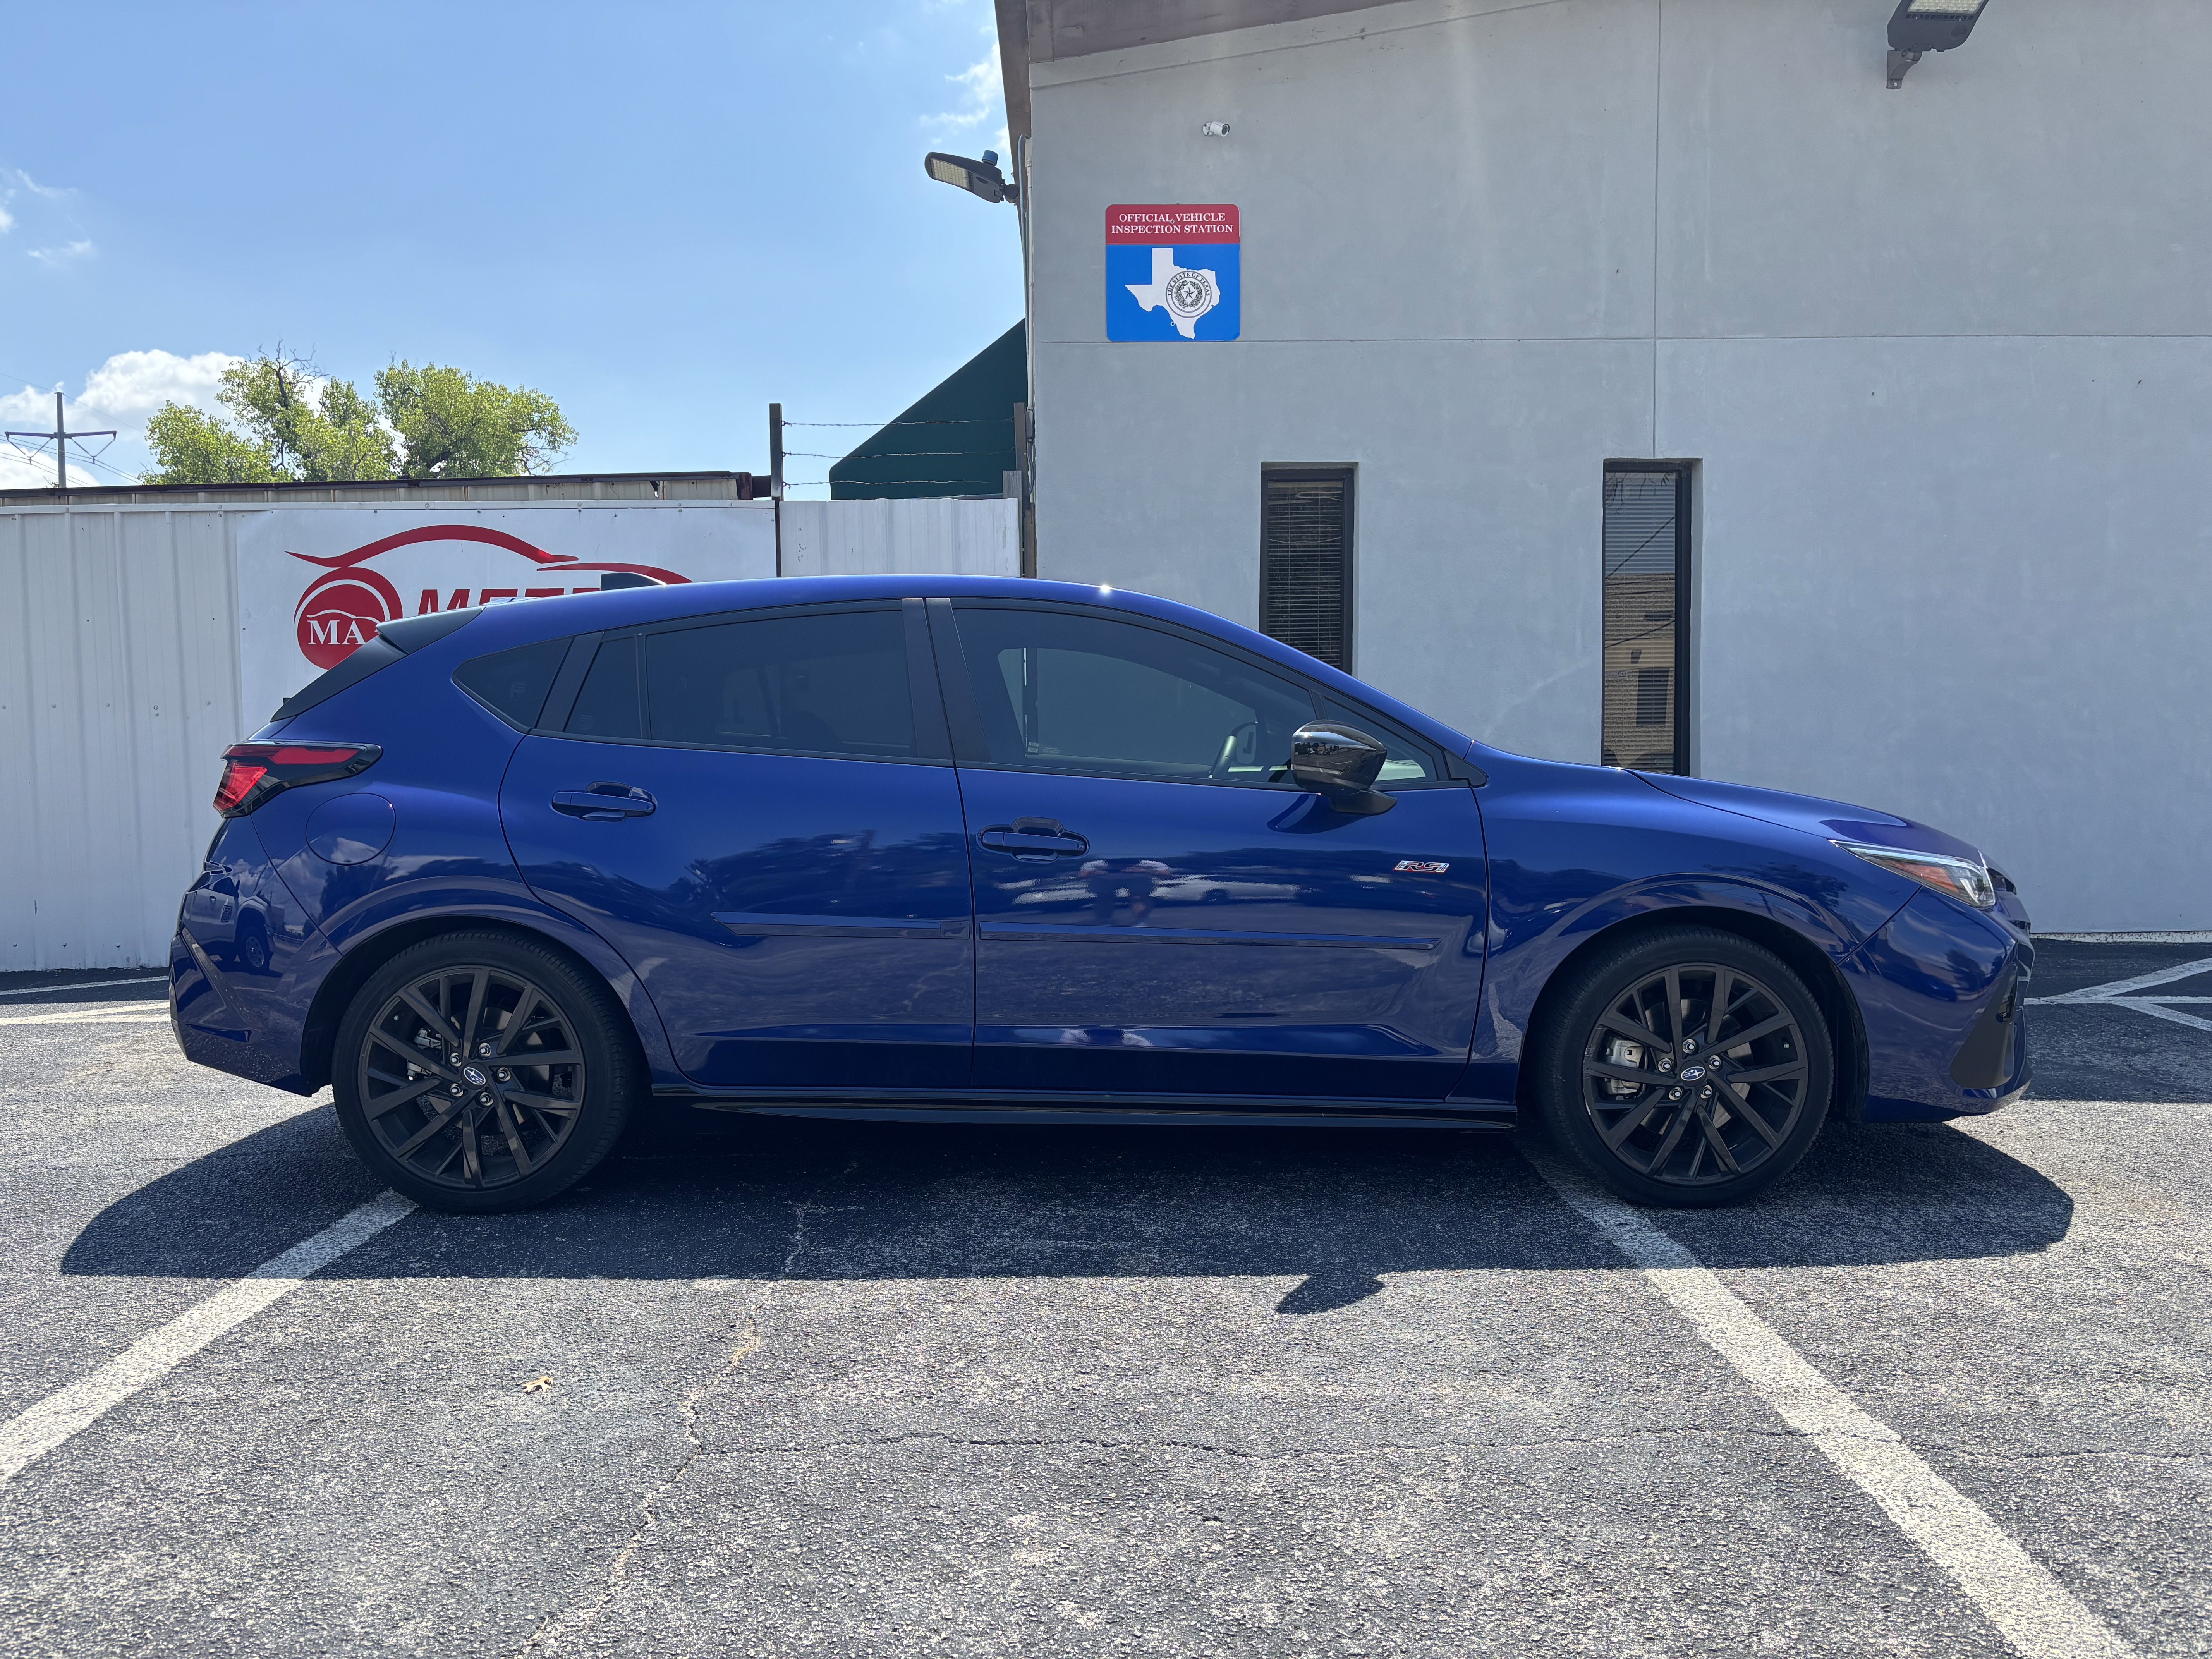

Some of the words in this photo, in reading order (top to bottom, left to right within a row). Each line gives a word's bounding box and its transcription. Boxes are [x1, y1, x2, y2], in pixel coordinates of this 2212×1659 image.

[1119, 213, 1173, 222] OFFICIAL
[1175, 213, 1225, 222] VEHICLE
[1111, 225, 1181, 234] INSPECTION
[1184, 225, 1233, 233] STATION
[1172, 272, 1190, 283] STATE
[1200, 277, 1210, 296] TEXAS
[1401, 861, 1443, 872] RS
